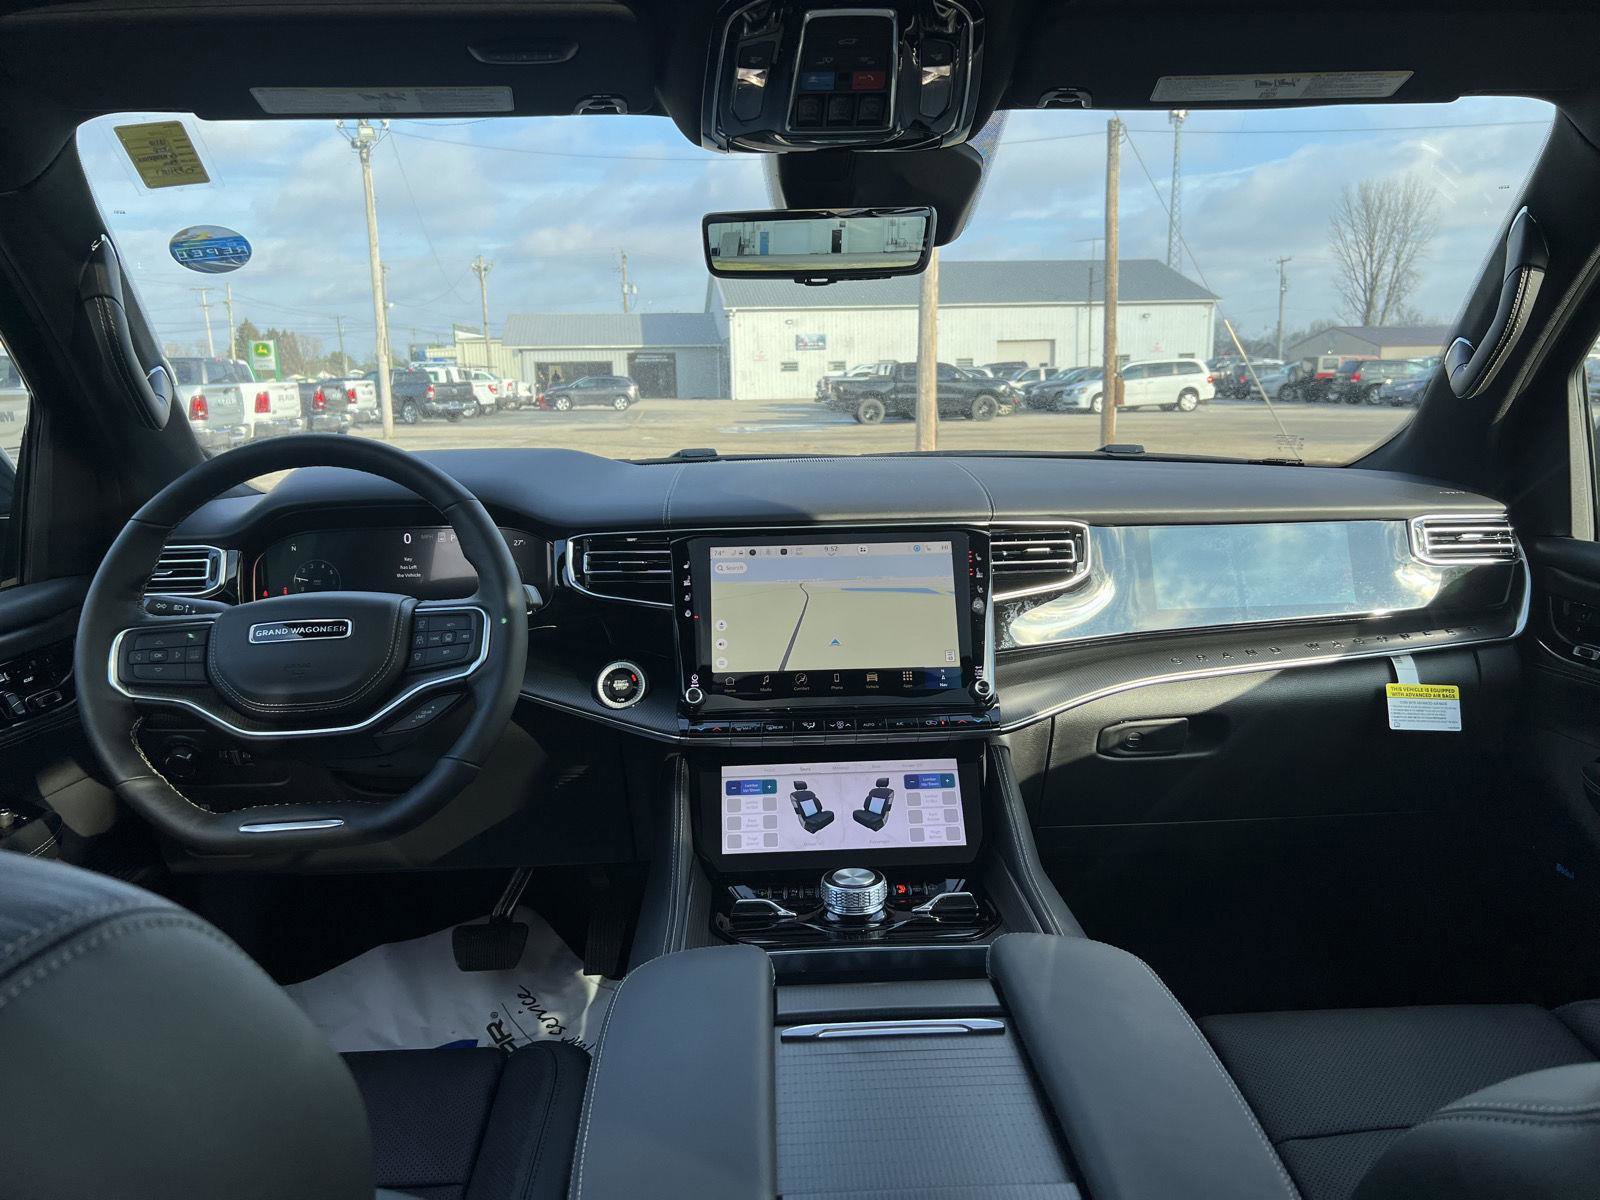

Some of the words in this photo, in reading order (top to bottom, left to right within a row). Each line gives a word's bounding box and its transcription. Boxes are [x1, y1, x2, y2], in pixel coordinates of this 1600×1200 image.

[403, 533, 412, 544] 0
[450, 533, 457, 541] P
[256, 629, 289, 637] GRAND
[290, 625, 346, 634] WAGONEER
